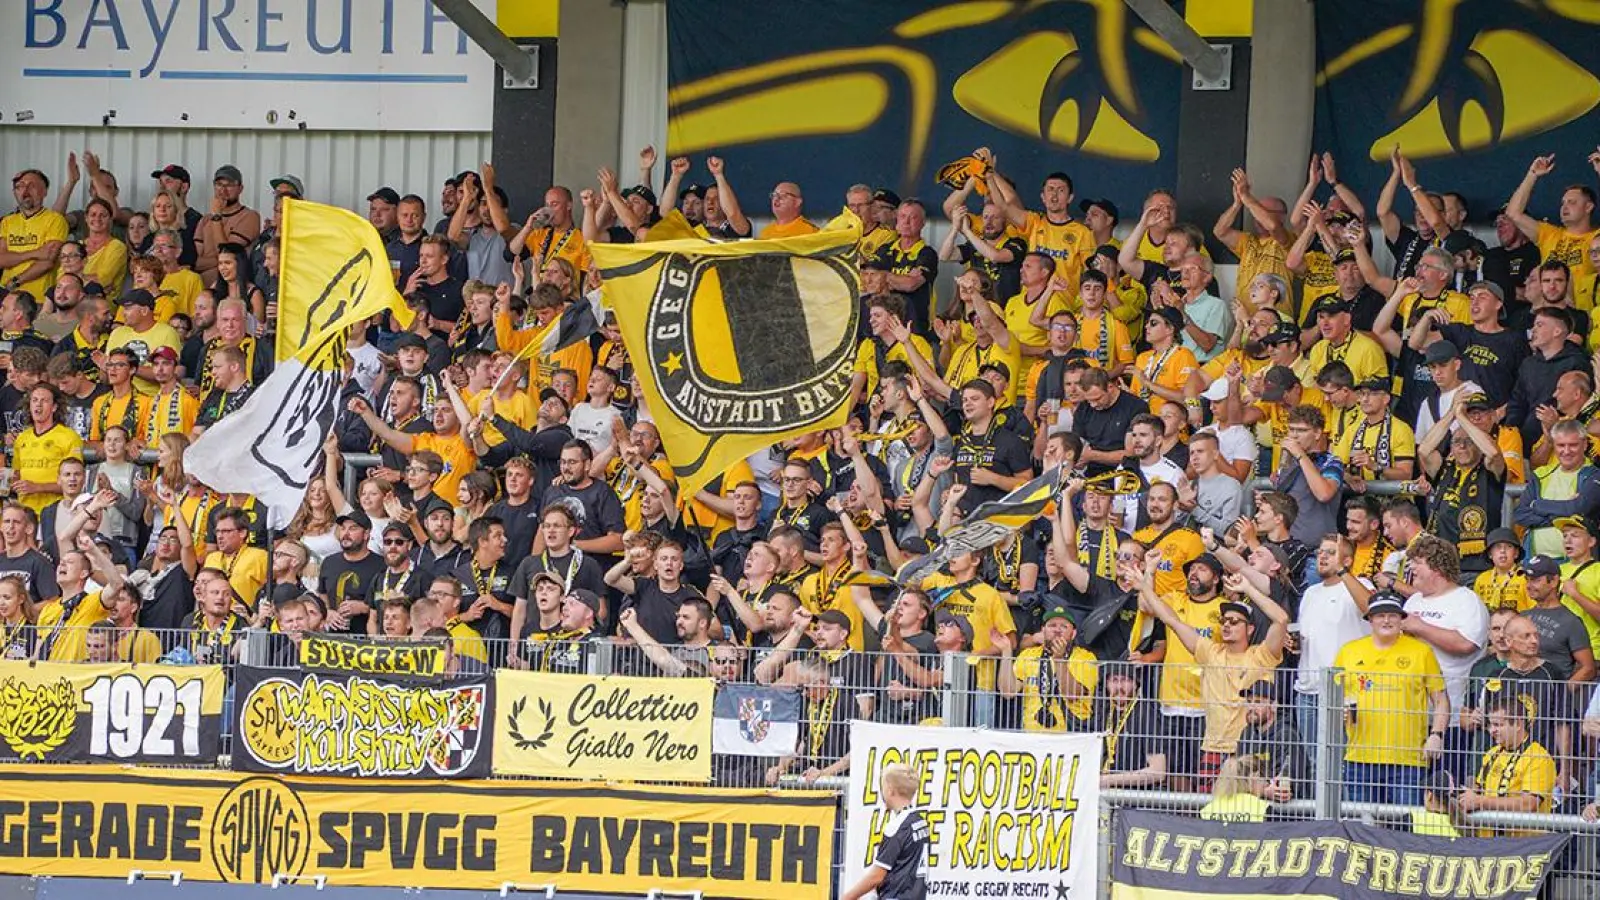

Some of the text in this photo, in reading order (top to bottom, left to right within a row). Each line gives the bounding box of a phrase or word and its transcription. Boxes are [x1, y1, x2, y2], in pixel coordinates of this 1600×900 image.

[656, 267, 689, 340] GEG
[675, 360, 855, 424] ALTSTADT BAYR
[307, 637, 438, 674] SUPCREW
[82, 673, 203, 758] 1921
[567, 683, 699, 726] Collettivo
[250, 731, 297, 759] BAYREUT
[566, 727, 699, 768] Giallo Nero
[941, 747, 1081, 812] FOOTBALL
[0, 800, 204, 861] GERADE
[316, 812, 497, 872] SPVGG
[530, 815, 820, 884] BAYREUTH
[863, 808, 1075, 874] HE RACISM
[1122, 826, 1551, 898] ALTSTADTFREUNDE
[926, 880, 1049, 898] ADTFANS GEGEN RECHTS
